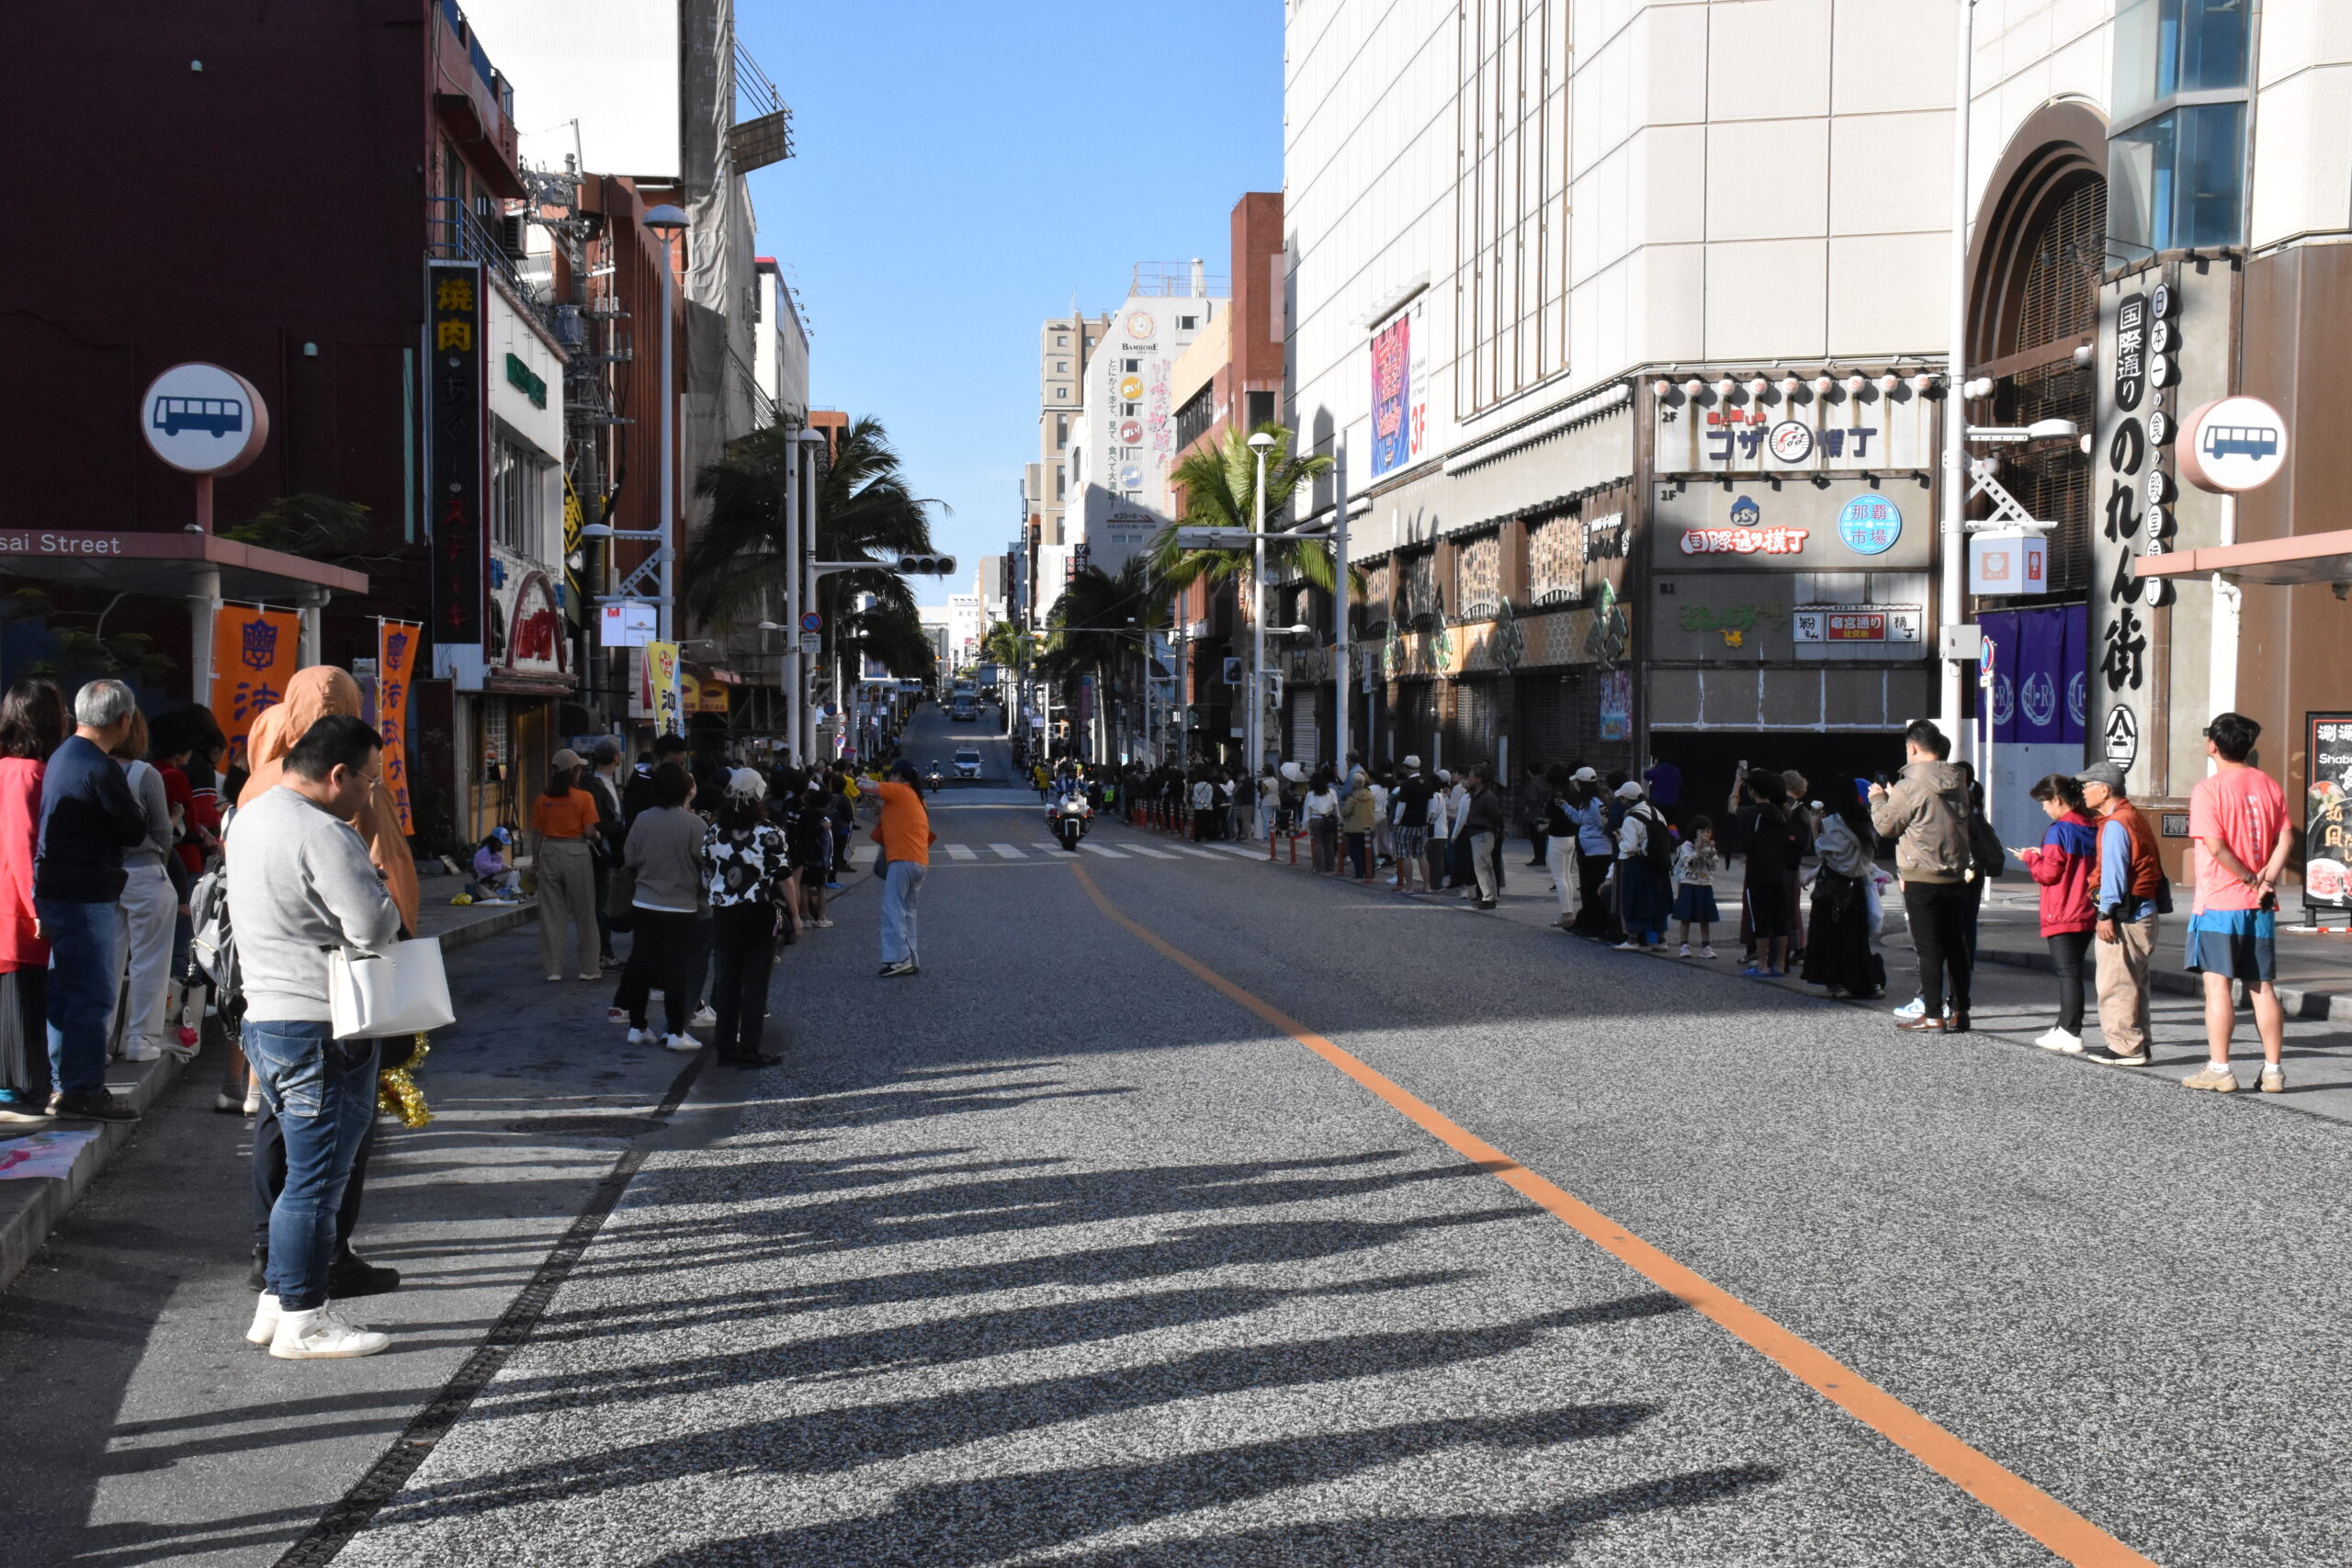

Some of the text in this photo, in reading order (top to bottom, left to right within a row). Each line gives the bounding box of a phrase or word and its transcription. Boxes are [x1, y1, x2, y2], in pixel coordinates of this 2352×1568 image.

[2117, 301, 2142, 403] 国際通り
[1662, 412, 1678, 423] 2F
[1411, 402, 1425, 456] 3F
[1661, 490, 1677, 501] 1F
[1852, 504, 1886, 520] 那覇
[40, 534, 121, 554] Street
[1681, 528, 1807, 554] 国際通り横丁
[1852, 529, 1886, 545] 市場
[2100, 417, 2146, 692] のれん街
[1659, 582, 1676, 594] B1
[1894, 616, 1915, 638] 横丁
[2319, 753, 2352, 764] Shab
